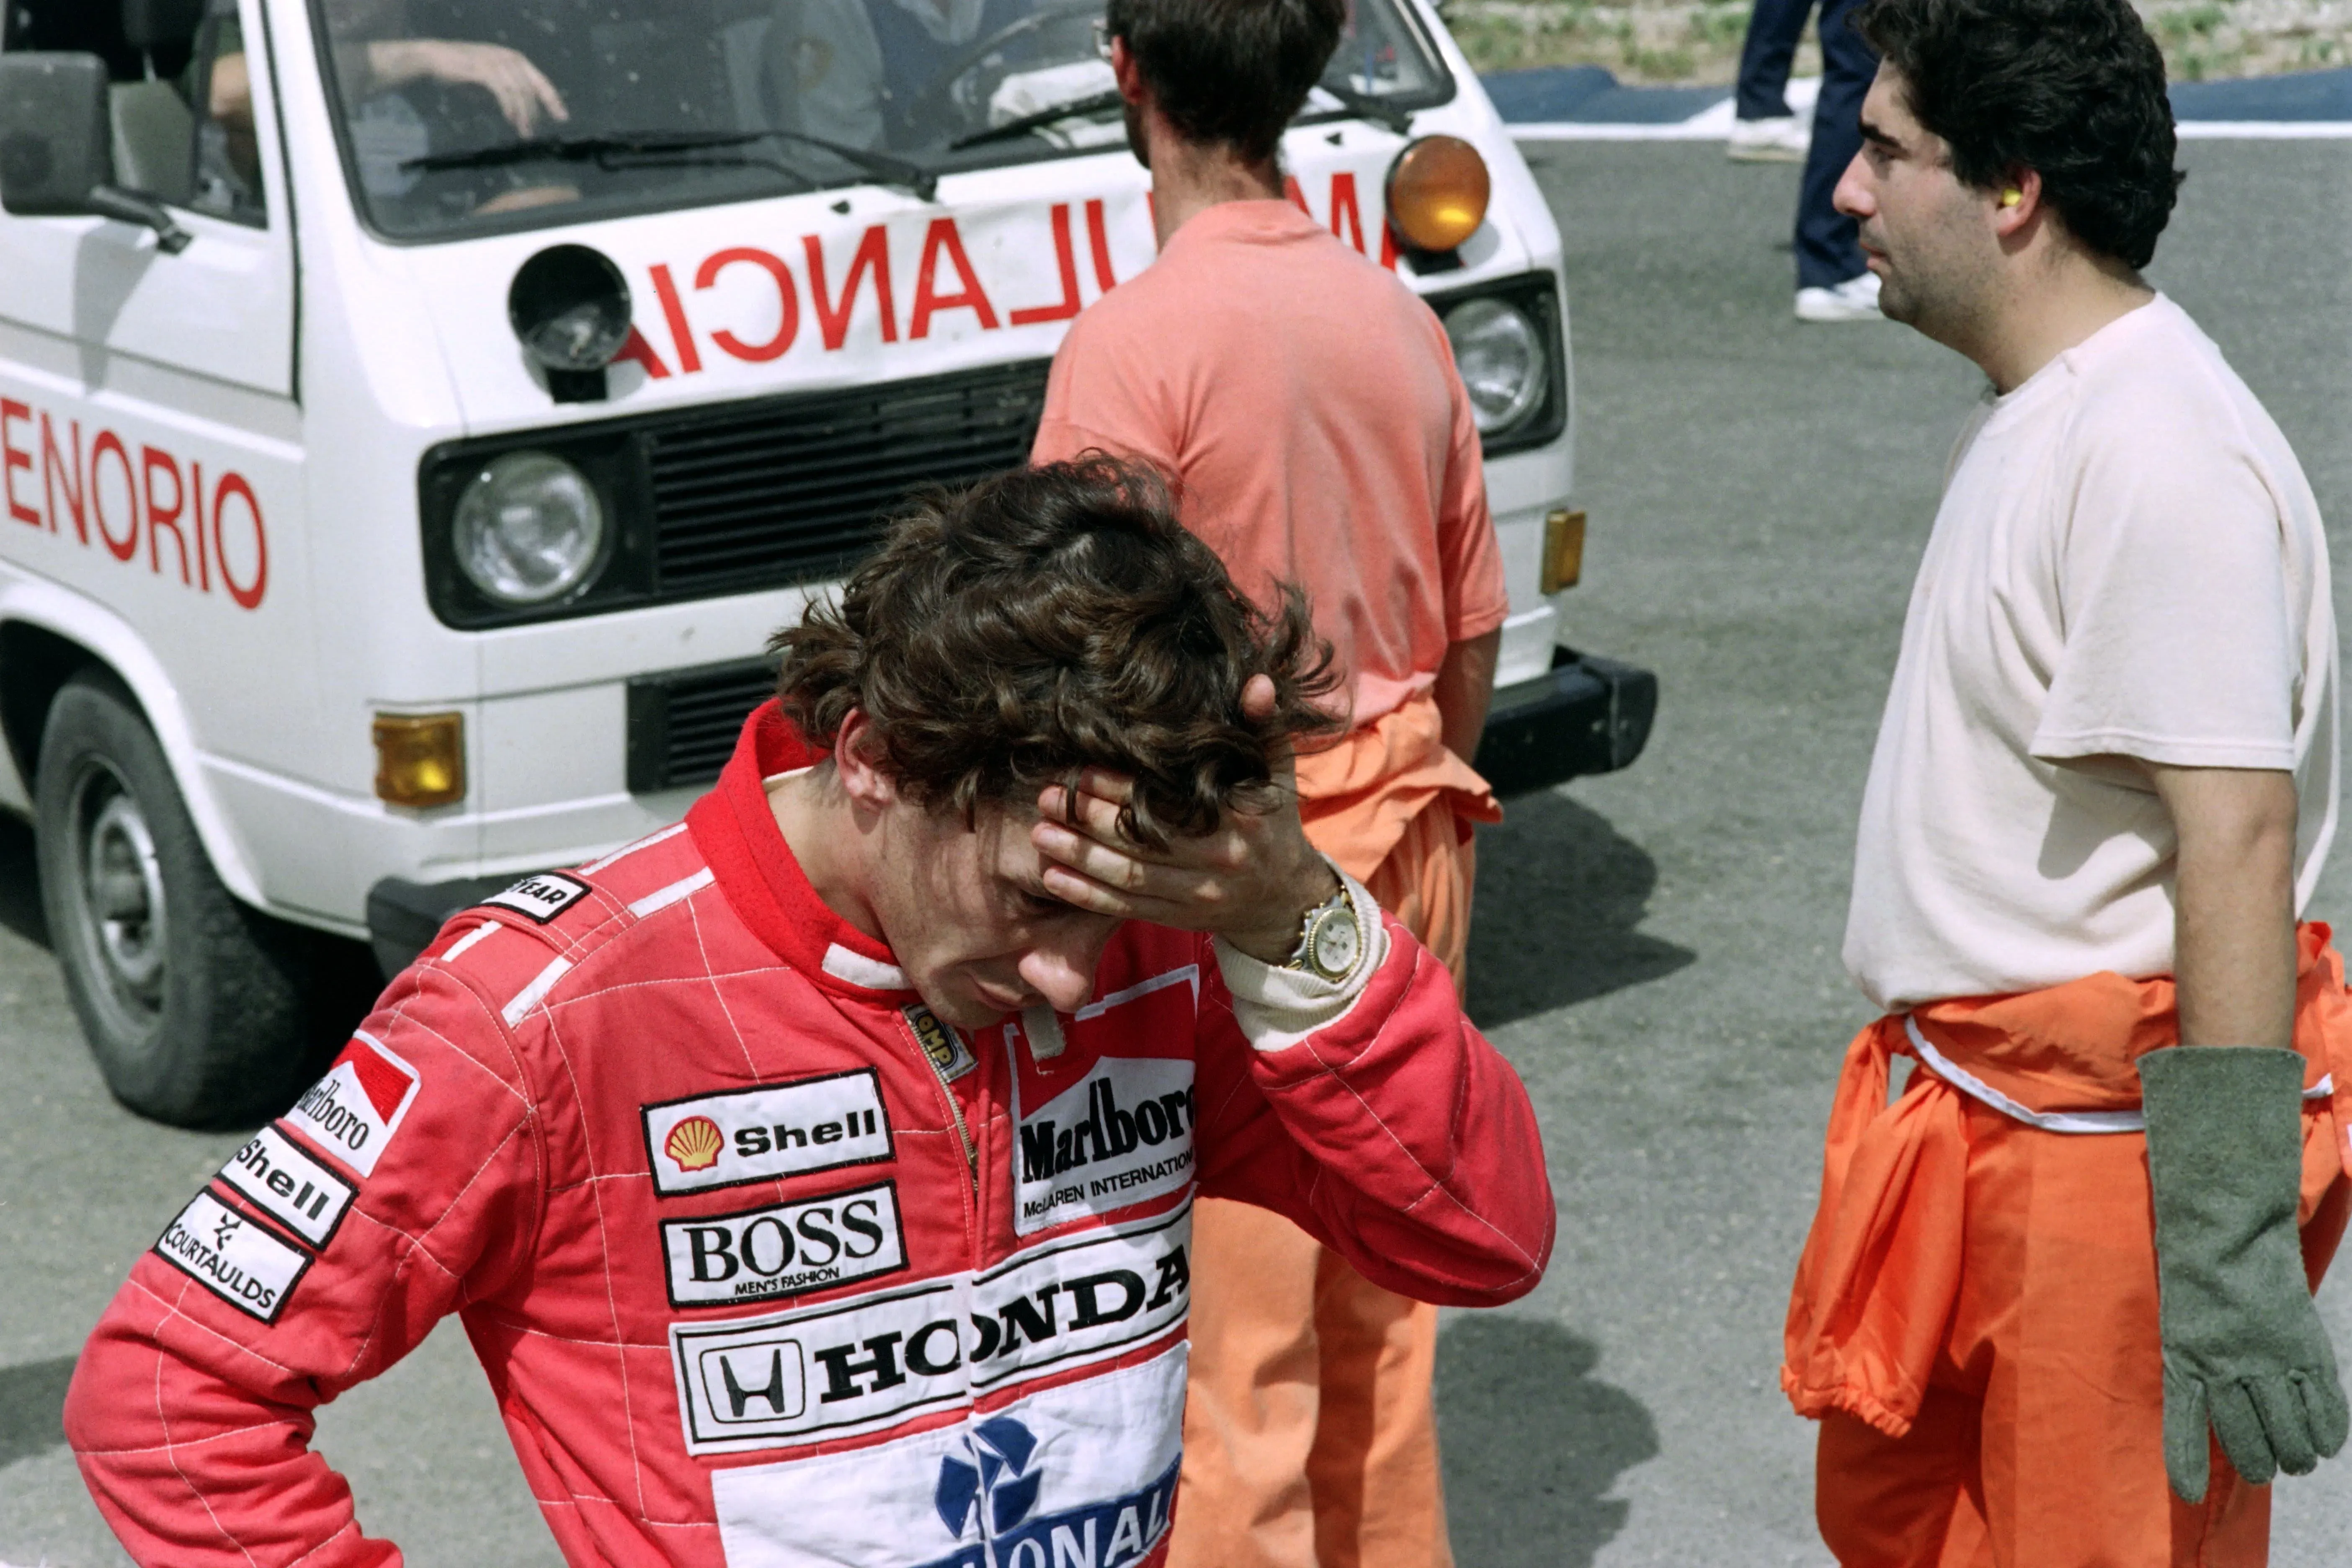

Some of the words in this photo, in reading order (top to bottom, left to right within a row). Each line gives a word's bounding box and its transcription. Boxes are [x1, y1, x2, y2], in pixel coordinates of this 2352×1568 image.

[918, 1015, 952, 1064] OMP
[297, 1078, 369, 1150] rlboro
[734, 1109, 877, 1157] Shell
[236, 1138, 330, 1221] Shell
[1024, 1184, 1085, 1218] McLAREN
[165, 1222, 276, 1309] COURTAULDS
[682, 1199, 883, 1282] BOSS
[735, 1278, 778, 1295] MEN'S
[781, 1266, 840, 1289] FASHION
[814, 1243, 1189, 1404] HONDA
[963, 1488, 1163, 1568] ONAL
